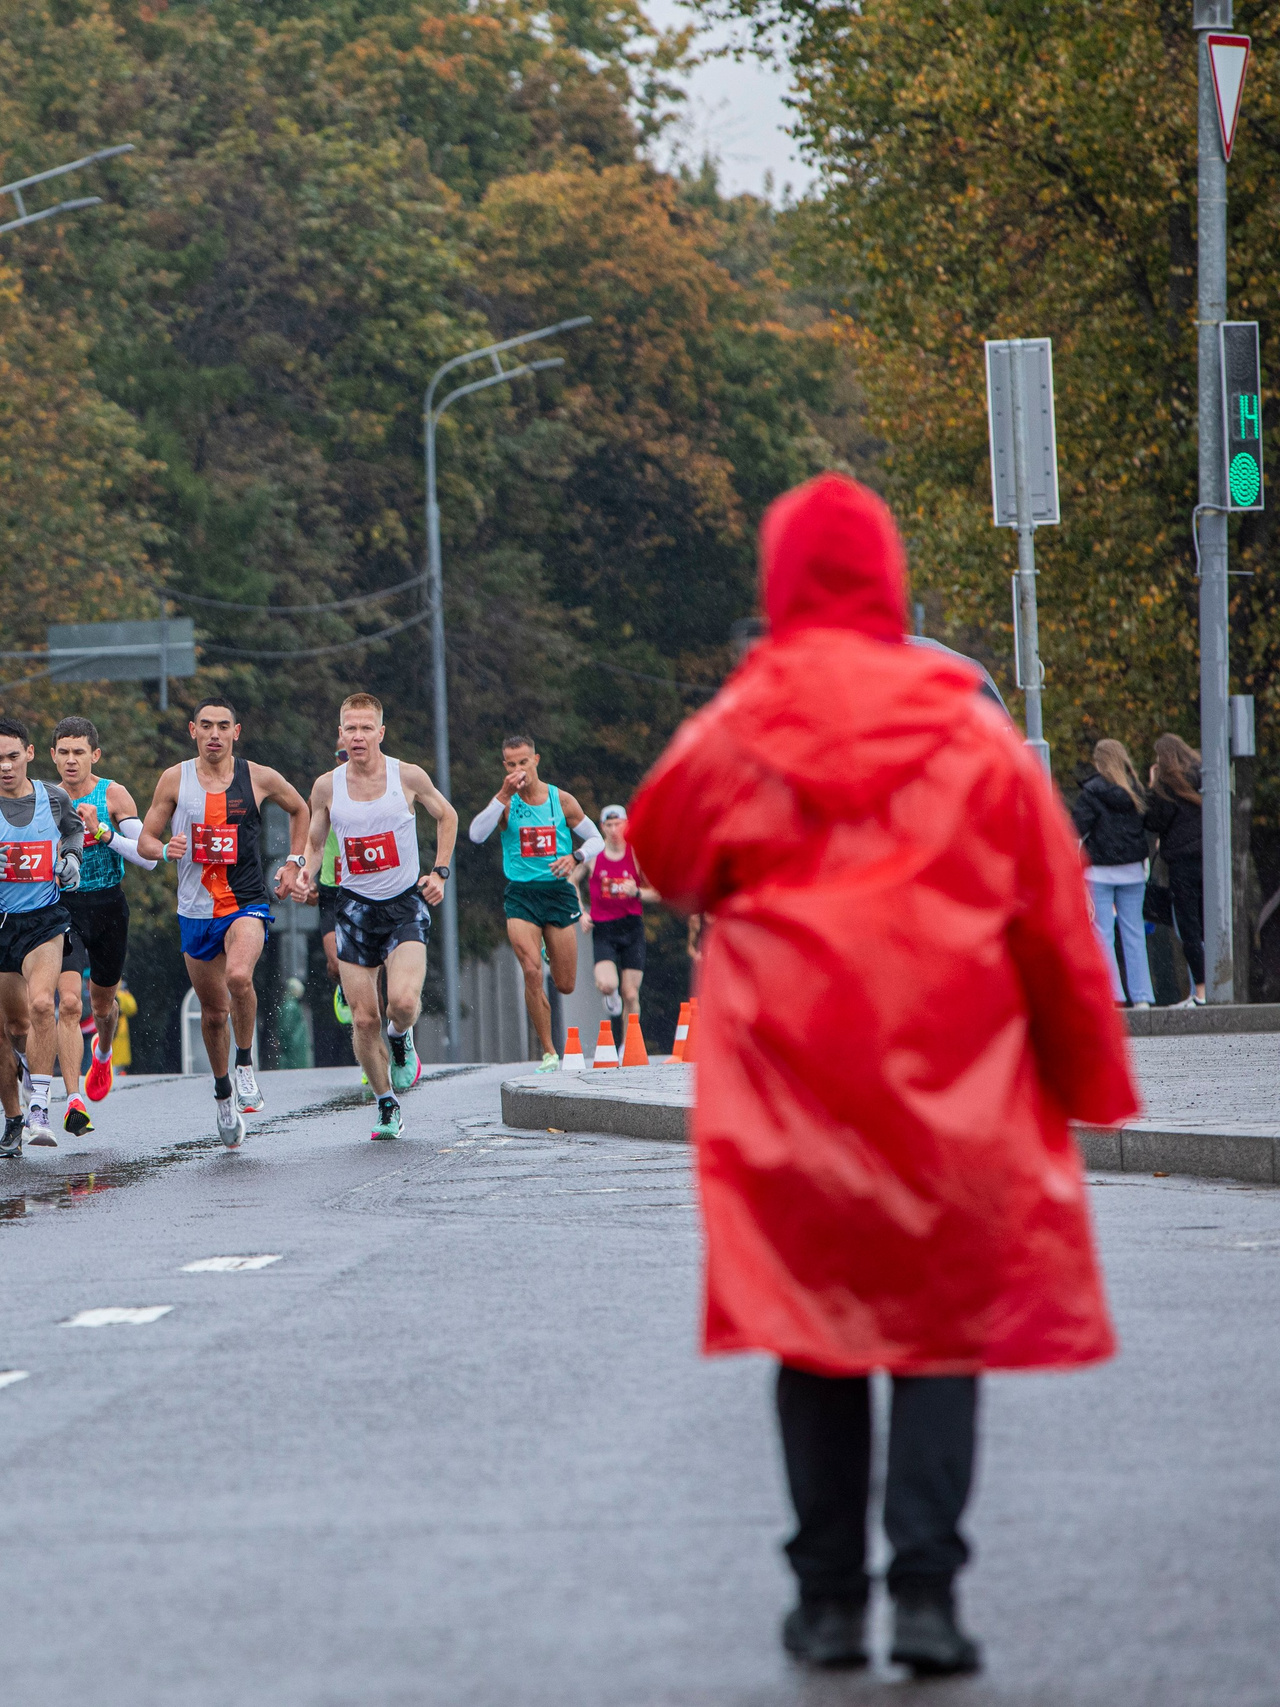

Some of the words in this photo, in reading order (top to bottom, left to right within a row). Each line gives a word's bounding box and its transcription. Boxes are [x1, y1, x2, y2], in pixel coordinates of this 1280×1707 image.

[210, 836, 234, 852] 32
[536, 834, 552, 848] 21
[19, 853, 43, 870] 27
[363, 845, 386, 862] 01
